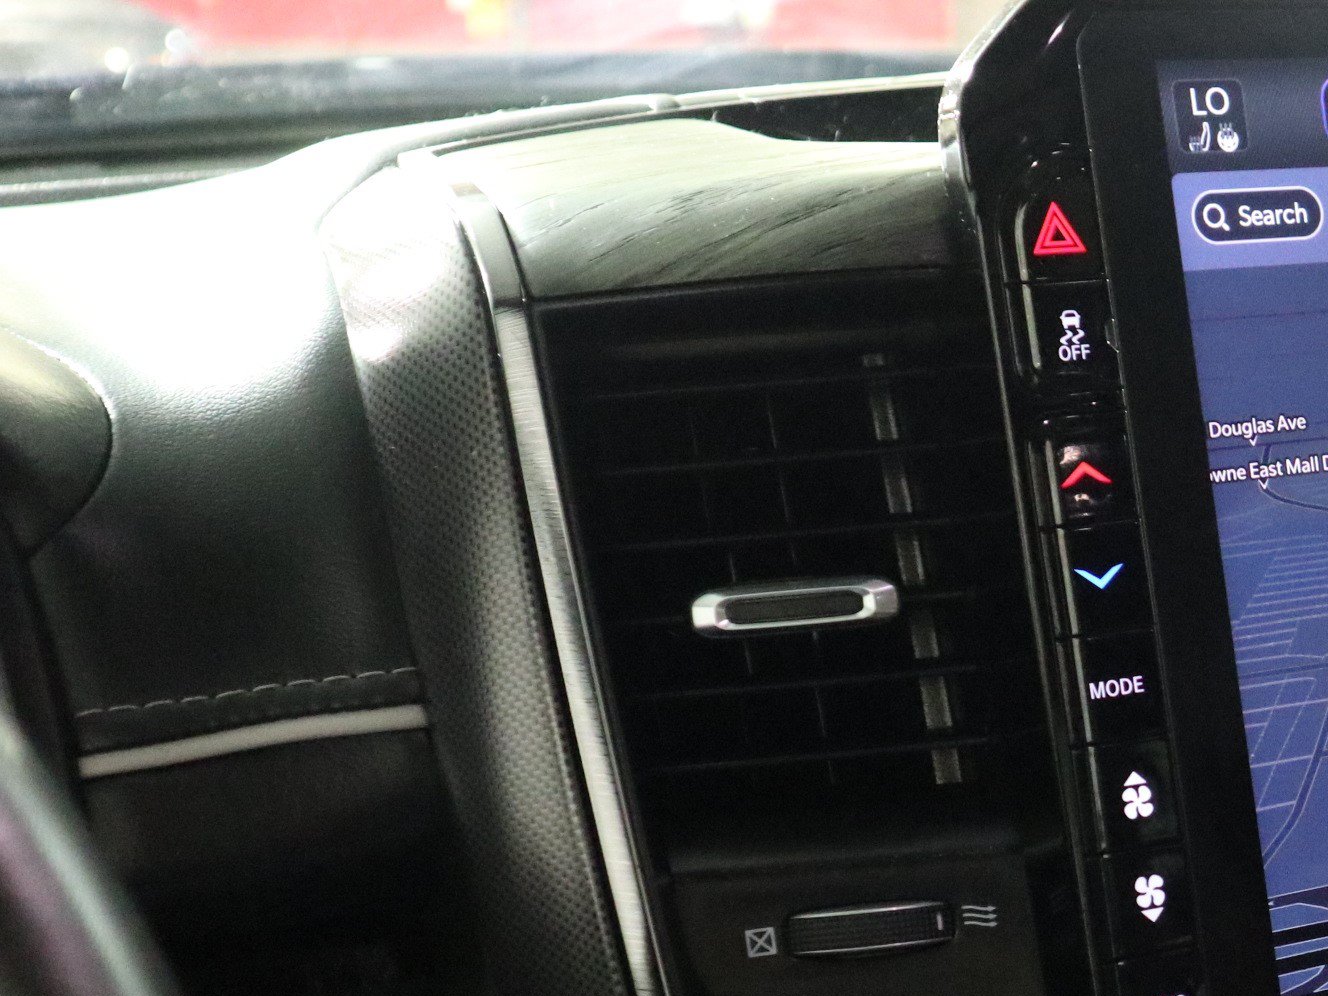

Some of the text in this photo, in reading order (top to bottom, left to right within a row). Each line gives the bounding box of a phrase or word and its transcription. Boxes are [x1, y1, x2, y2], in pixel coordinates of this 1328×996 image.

[1189, 86, 1231, 117] LO
[1237, 201, 1309, 228] Search
[1058, 344, 1091, 362] OFF
[1208, 414, 1307, 438] Douglas Ave
[1209, 467, 1247, 484] wne
[1249, 461, 1283, 480] East
[1285, 455, 1319, 474] Mall
[1088, 675, 1145, 700] MODE
